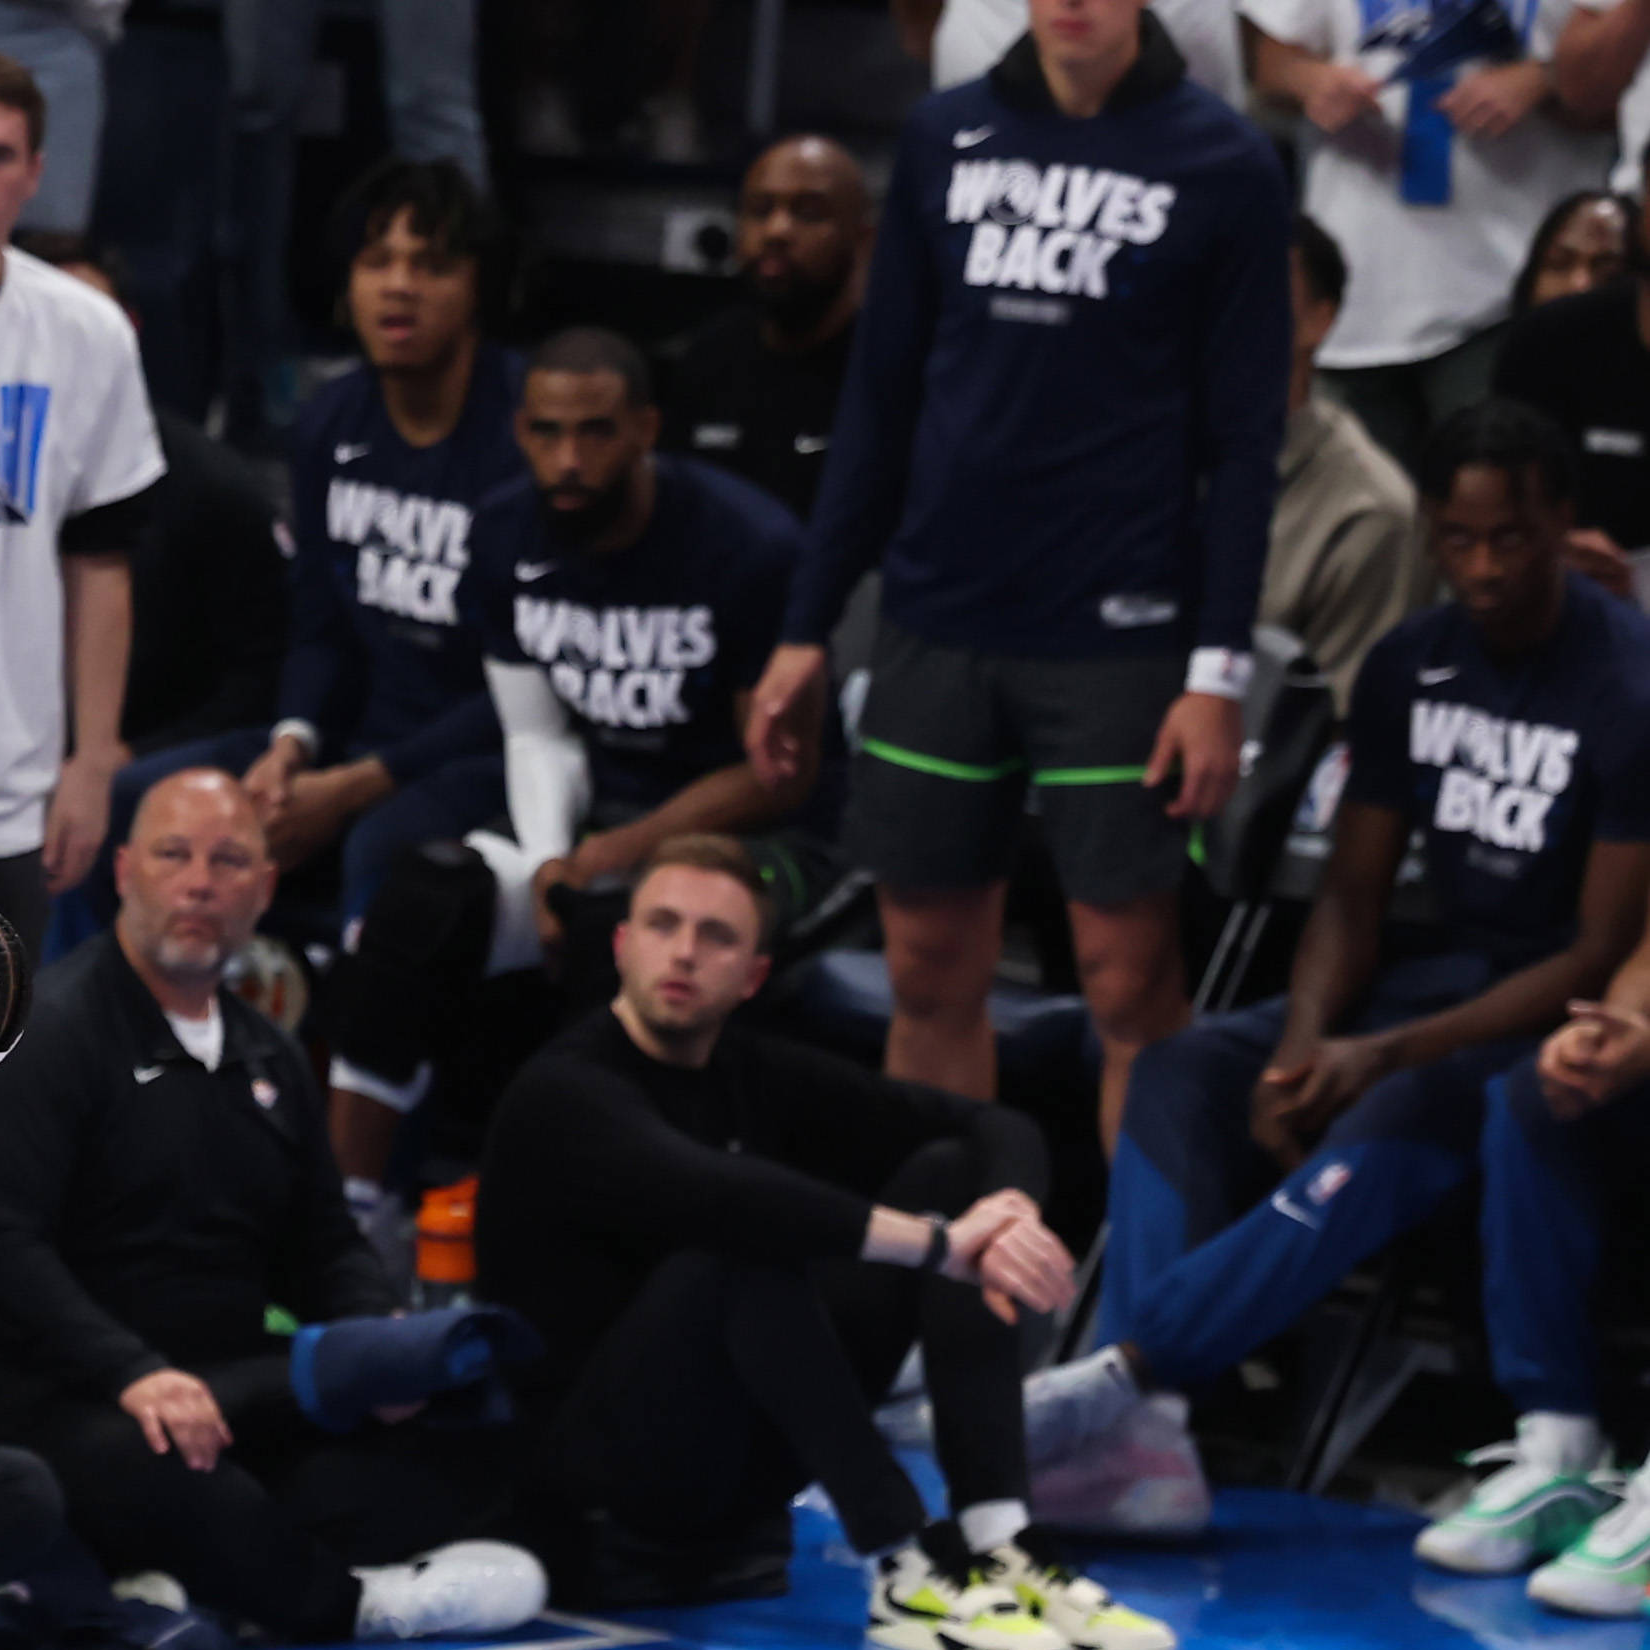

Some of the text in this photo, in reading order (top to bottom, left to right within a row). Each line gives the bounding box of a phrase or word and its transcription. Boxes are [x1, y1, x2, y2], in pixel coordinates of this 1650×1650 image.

[946, 159, 1178, 245] WOLVES
[964, 221, 1122, 300] BACK
[326, 478, 474, 569] WOLVE
[513, 595, 717, 670] WOLVES
